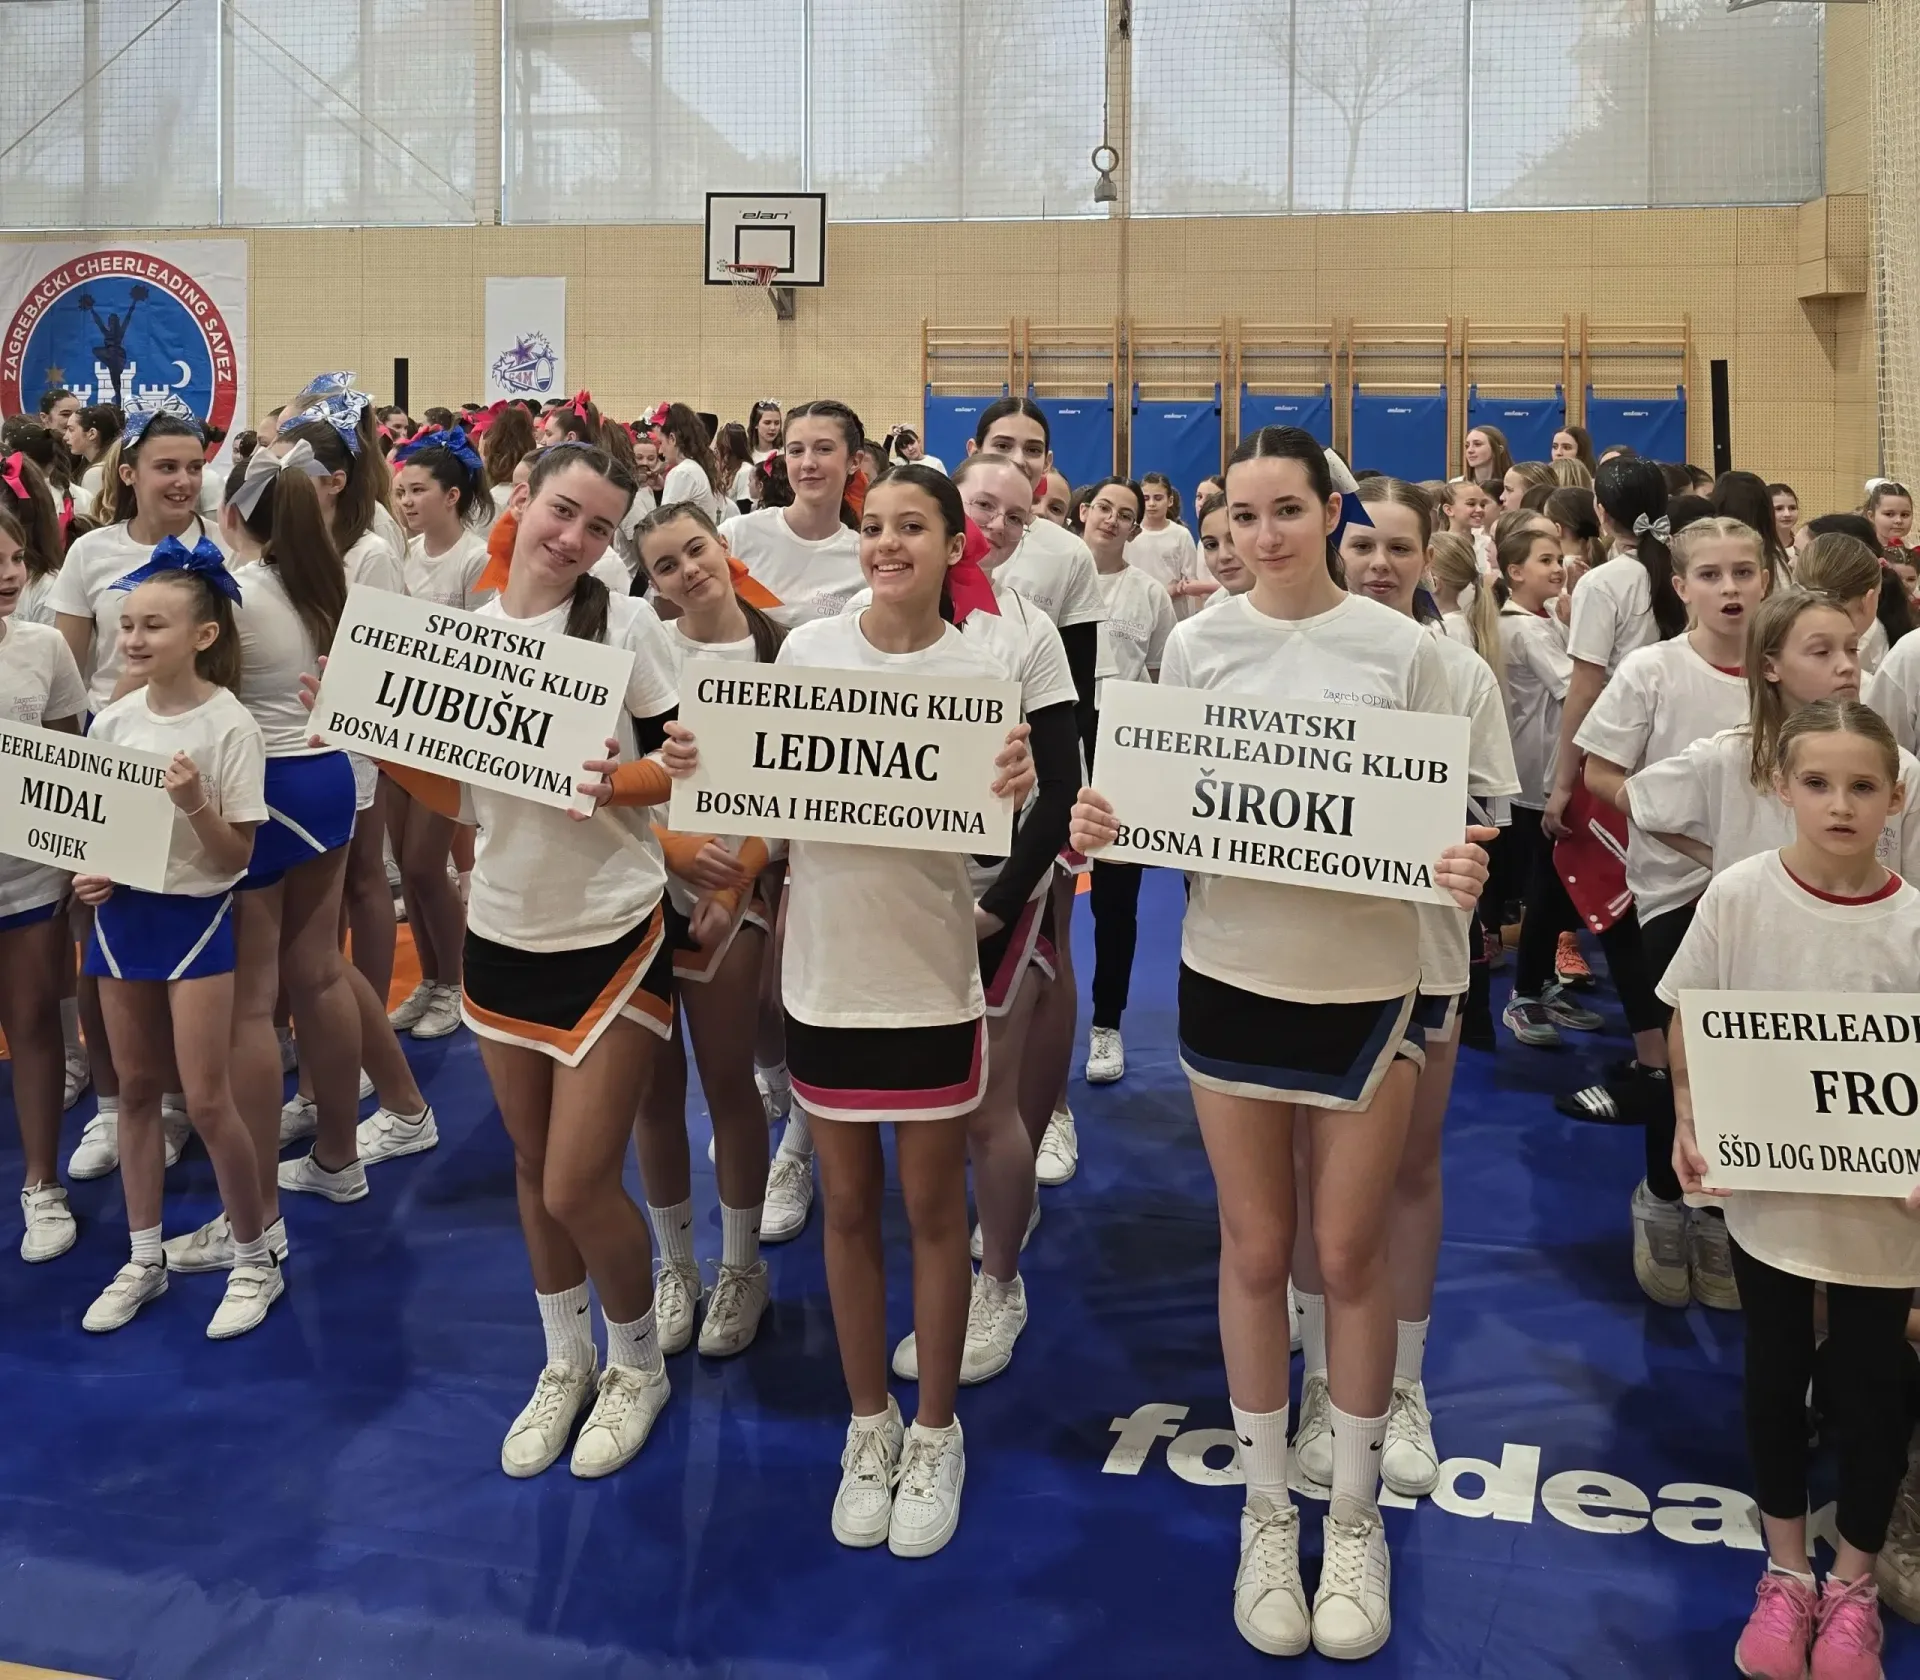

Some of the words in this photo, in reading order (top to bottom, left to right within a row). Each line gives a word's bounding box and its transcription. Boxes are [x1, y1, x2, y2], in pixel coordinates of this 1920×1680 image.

[742, 211, 788, 219] elan
[4, 271, 71, 381] ZAGREBAČKI
[75, 256, 208, 316] CHEERLEADING
[205, 318, 232, 382] SAVEZ
[425, 614, 546, 660] SPORTSKI
[350, 624, 535, 688] CHEERLEADING
[541, 672, 609, 706] KLUB
[375, 670, 553, 749] LJUBUŠKI
[697, 679, 918, 717] CHEERLEADING
[926, 695, 1004, 724] KLUB
[1323, 688, 1359, 703] Zagreb
[1362, 694, 1393, 709] OPEN
[1204, 704, 1356, 742] HRVATSKI
[0, 733, 112, 777] EERLEADING
[328, 712, 399, 749] BOSNA
[405, 733, 415, 751] I
[417, 736, 573, 797] HERCEGOVINA
[752, 731, 940, 781] LEDINAC
[1114, 725, 1353, 773] CHEERLEADING
[1362, 753, 1448, 784] KLUB
[20, 776, 107, 825] MIDAL
[695, 791, 780, 818] BOSNA
[788, 797, 797, 820] I
[804, 799, 986, 835] HERCEGOVINA
[1192, 767, 1356, 837] ŠIROKI
[27, 828, 88, 860] OSIJEK
[1113, 824, 1203, 858] BOSNA
[1212, 837, 1220, 859] I
[1229, 840, 1432, 888] HERCEGOVINA
[1810, 1070, 1919, 1117] FRO
[1718, 1134, 1761, 1167] ŠŠD
[1766, 1142, 1814, 1170] LOG
